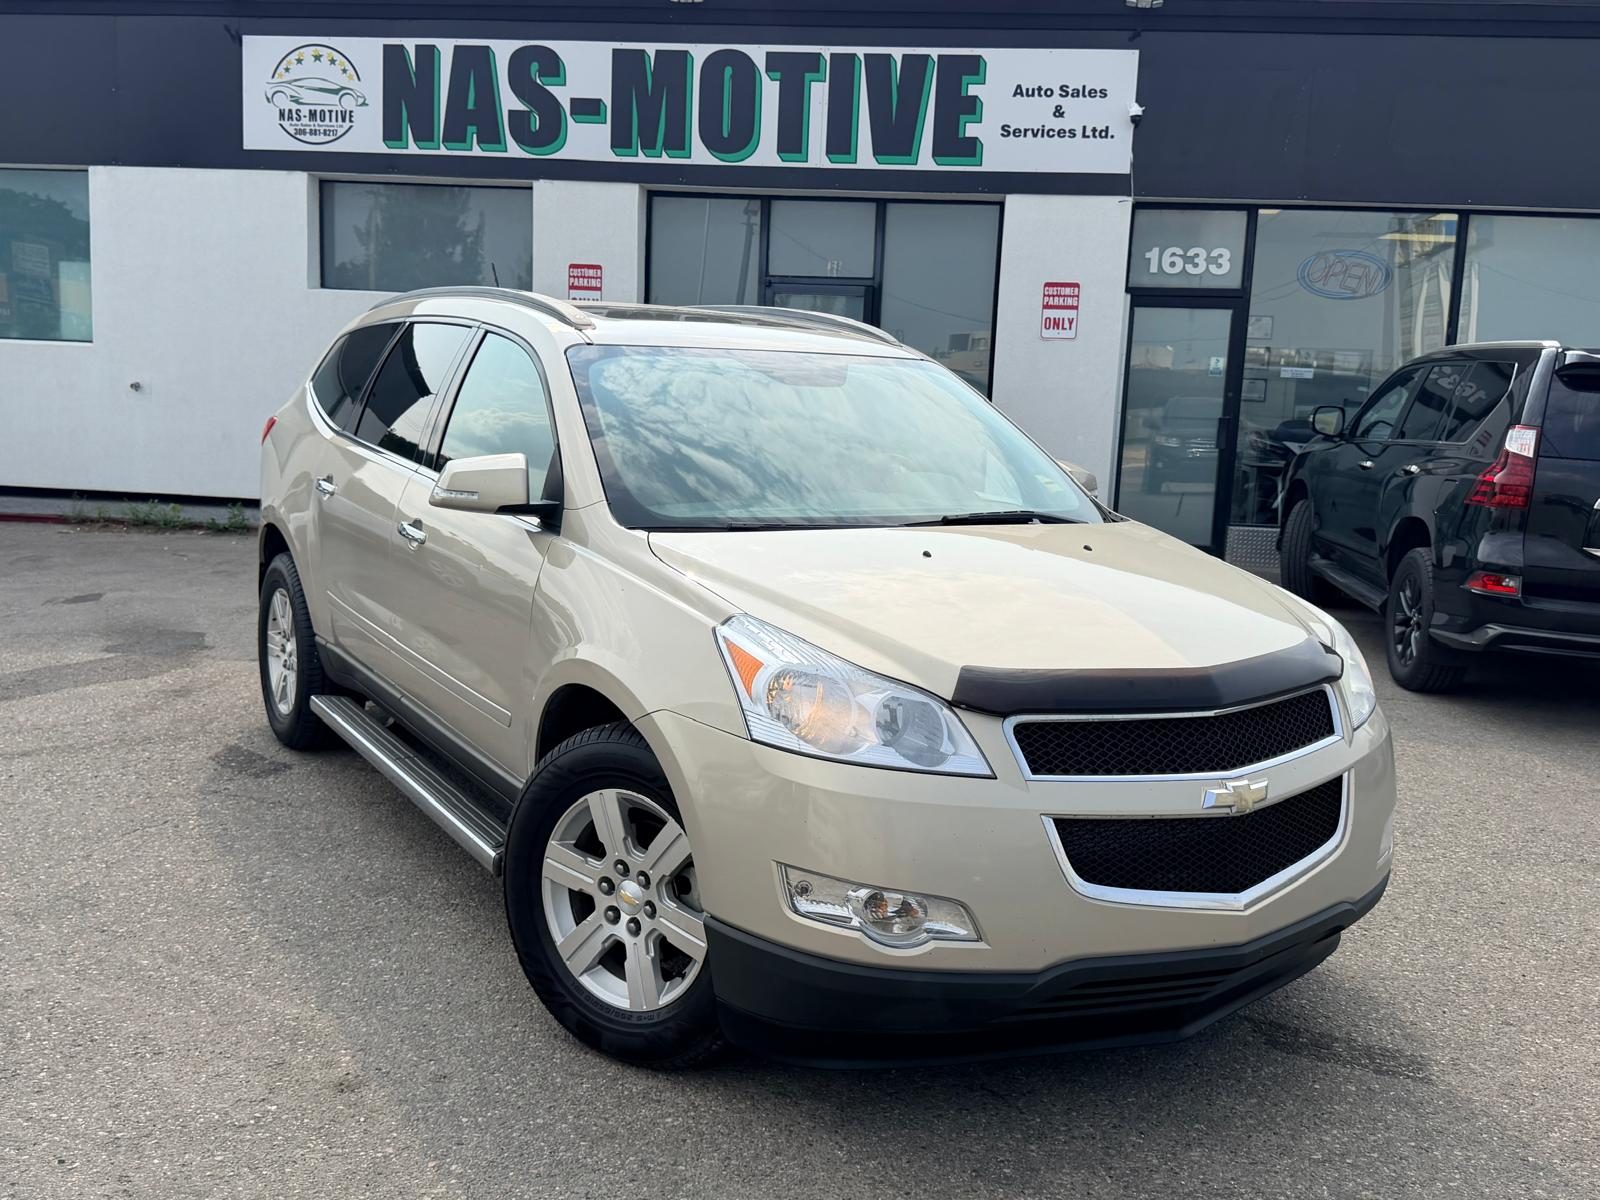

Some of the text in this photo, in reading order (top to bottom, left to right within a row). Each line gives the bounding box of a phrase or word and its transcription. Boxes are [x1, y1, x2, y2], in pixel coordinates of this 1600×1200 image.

[1012, 83, 1108, 99] Auto Sales
[382, 43, 988, 166] NAS-MOTIVE
[1052, 104, 1066, 119] &
[278, 108, 355, 123] NAS-MOTIVE
[999, 123, 1116, 140] Services Ltd.
[1144, 246, 1232, 276] 1633
[569, 268, 602, 277] CUSTOMER
[1304, 252, 1381, 295] OPEN
[569, 277, 602, 287] PARKING
[1044, 286, 1079, 296] CUSTOMER
[1043, 296, 1078, 306] PARKING
[1044, 316, 1075, 331] ONLY
